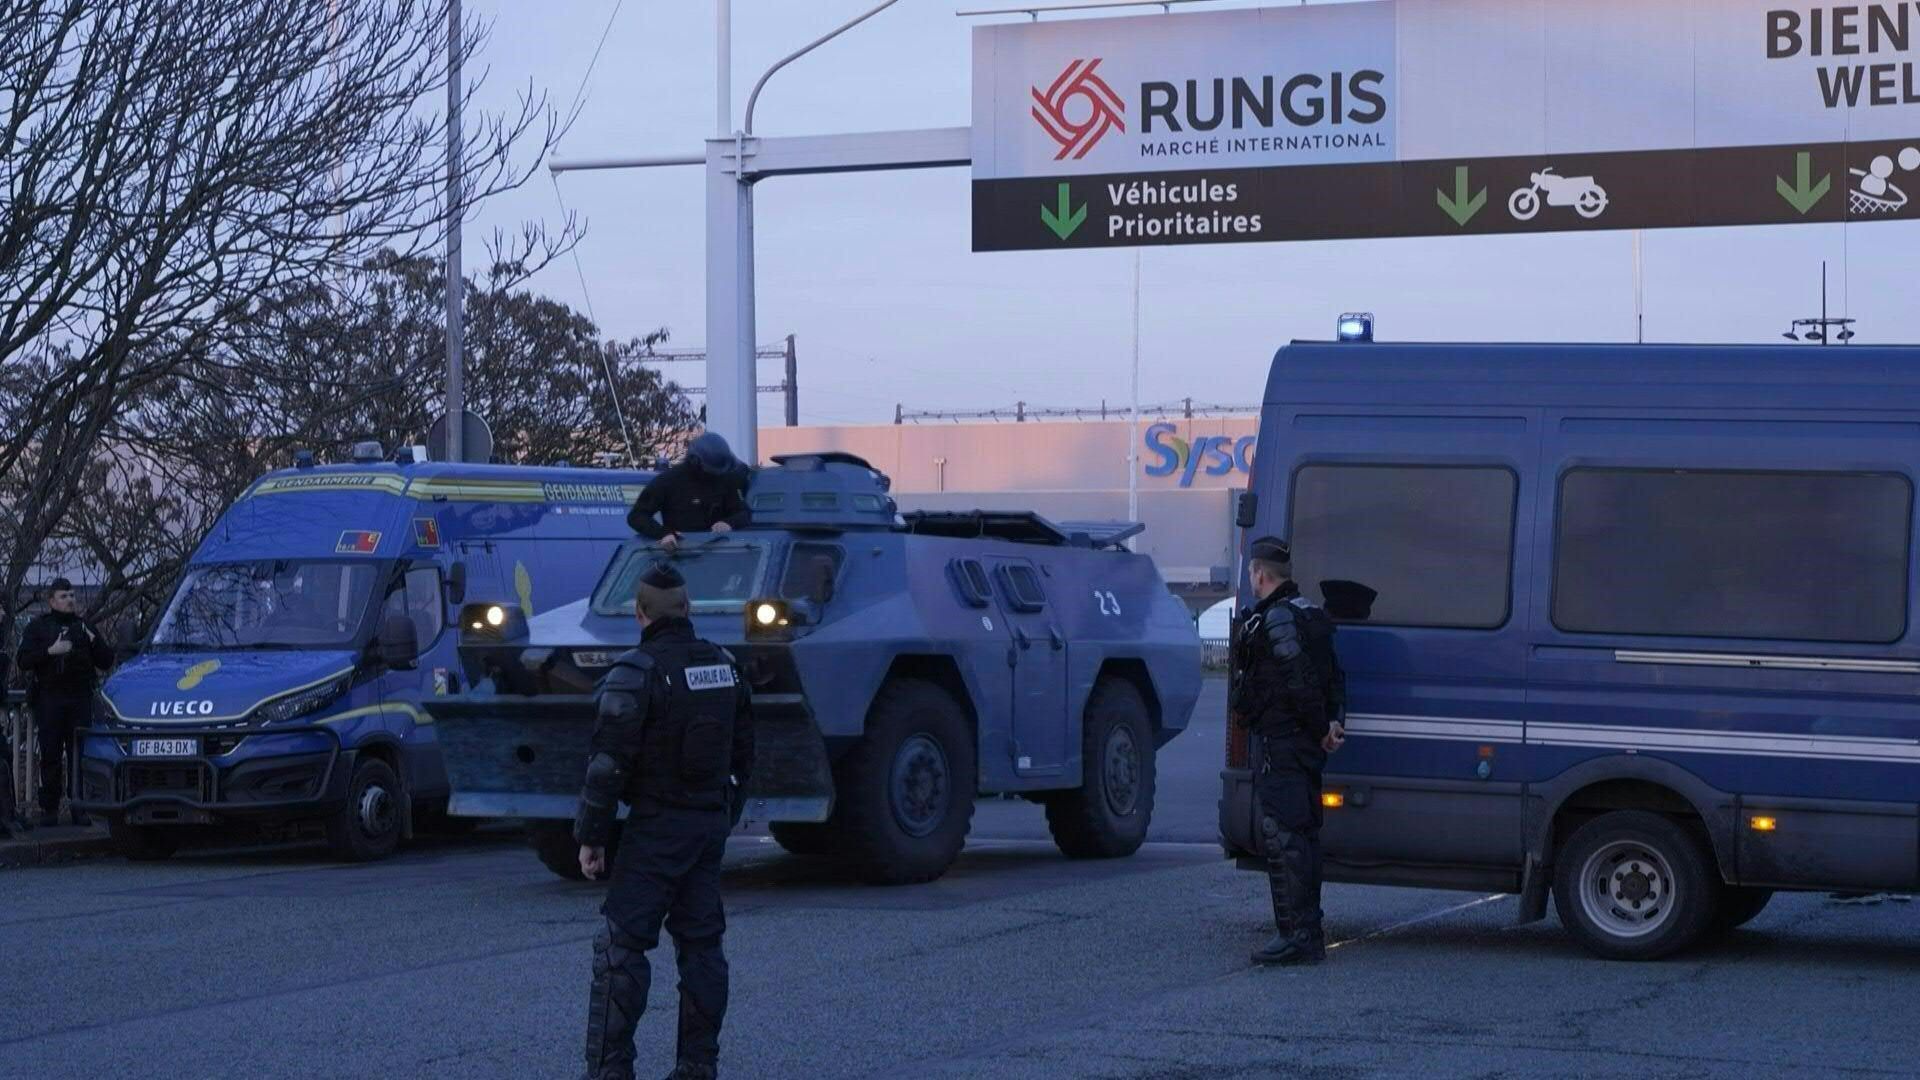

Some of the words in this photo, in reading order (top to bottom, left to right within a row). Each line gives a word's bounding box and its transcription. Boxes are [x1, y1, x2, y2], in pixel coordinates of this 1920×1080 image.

[1816, 62, 1920, 108] WEL
[1141, 69, 1386, 133] RUNGIS
[1141, 137, 1219, 157] MARCHÉ
[1227, 132, 1386, 153] INTERNATIONAL
[1107, 178, 1238, 206] Véhicules
[1108, 211, 1262, 238] Prioritaires
[276, 476, 374, 488] GENDARMERIE
[544, 483, 624, 501] GENDARMERIE
[1094, 590, 1121, 616] 23
[688, 668, 718, 687] CHARLIE
[150, 700, 214, 716] IVECO
